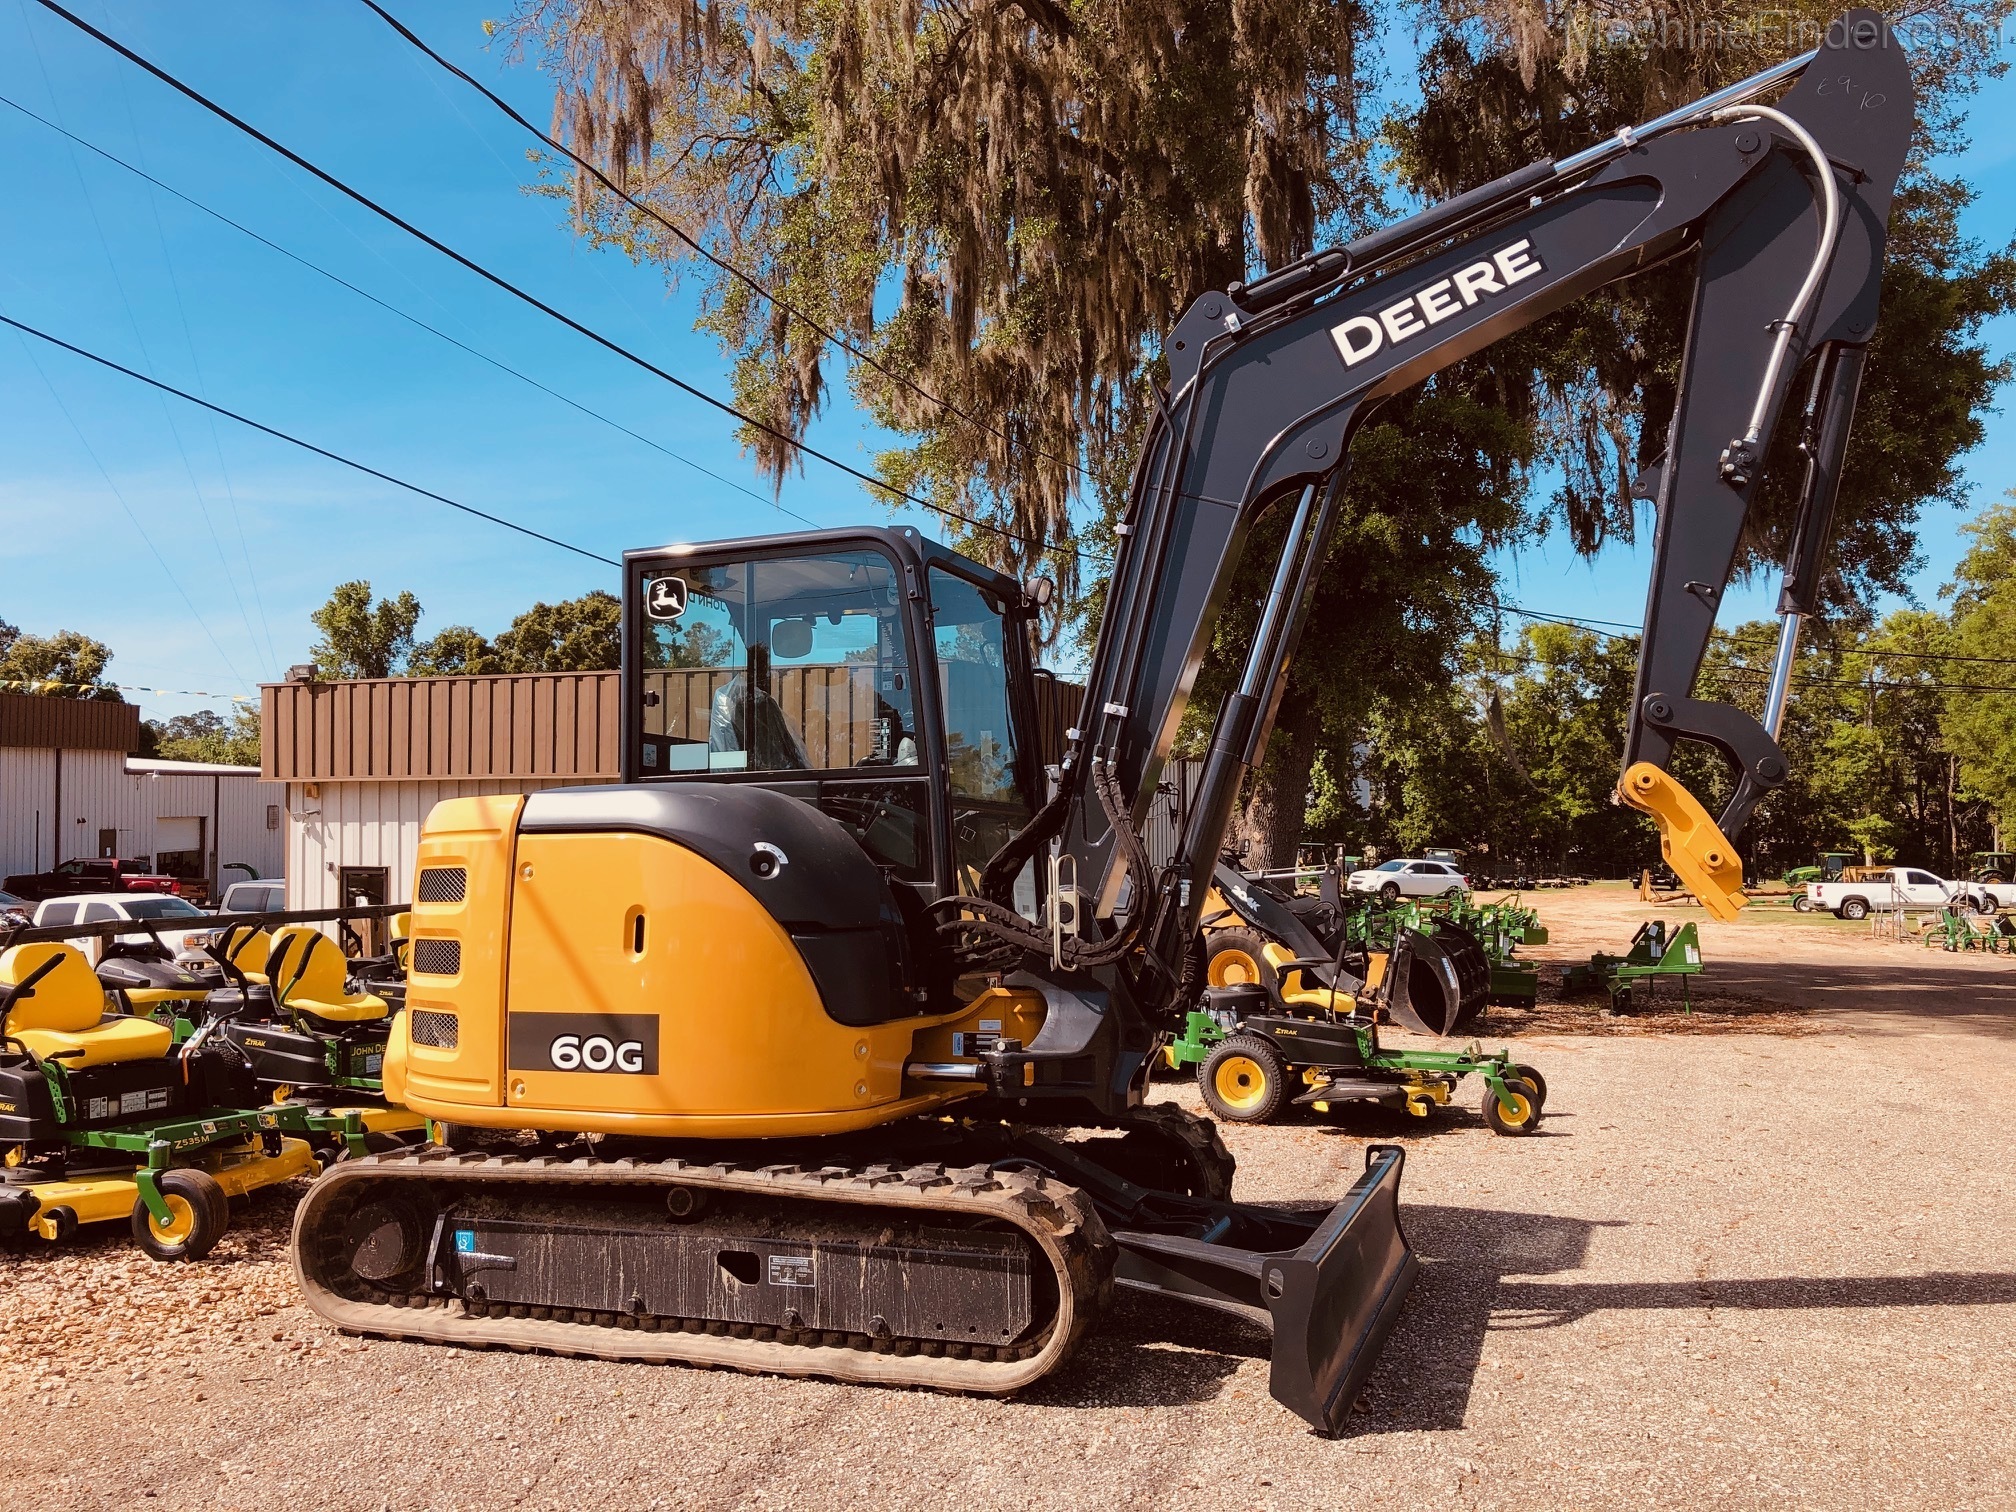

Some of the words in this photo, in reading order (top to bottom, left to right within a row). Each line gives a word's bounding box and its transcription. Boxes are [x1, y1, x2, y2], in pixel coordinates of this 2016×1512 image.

[1330, 238, 1542, 366] DEERE
[244, 1037, 267, 1048] ZTRAK
[351, 1046, 374, 1056] JOHN
[550, 1034, 644, 1073] 60G
[0, 1102, 16, 1112] RAK
[174, 1135, 210, 1150] Z535M
